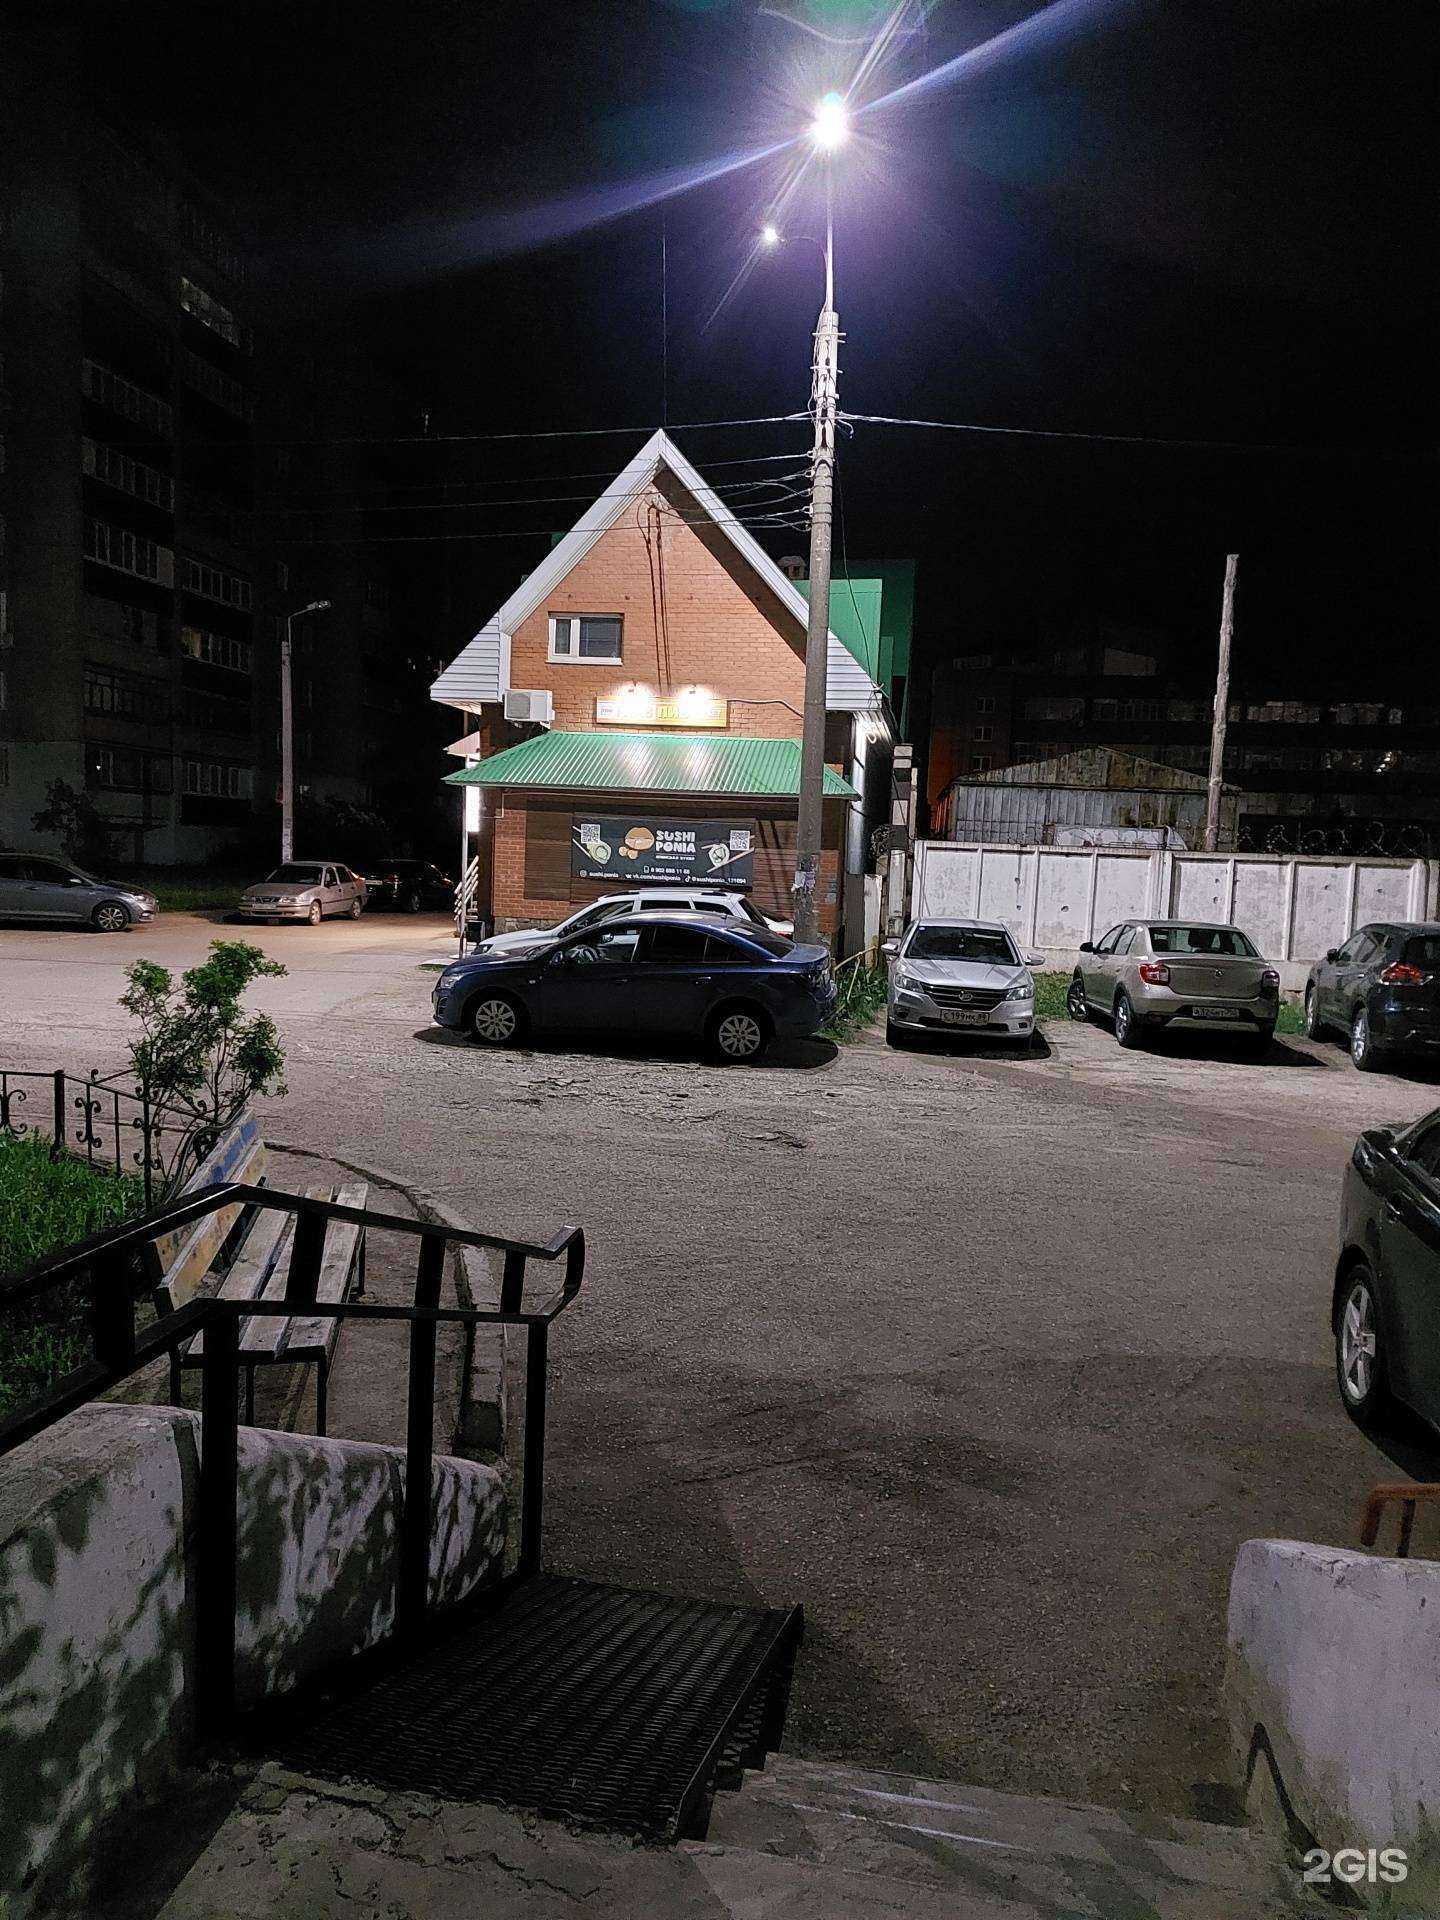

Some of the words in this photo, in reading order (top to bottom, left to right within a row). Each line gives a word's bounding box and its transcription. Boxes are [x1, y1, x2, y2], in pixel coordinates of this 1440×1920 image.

[656, 830, 695, 842] SUSHI
[655, 841, 696, 853] PONIA
[633, 873, 681, 881] vk.com/sushiponia
